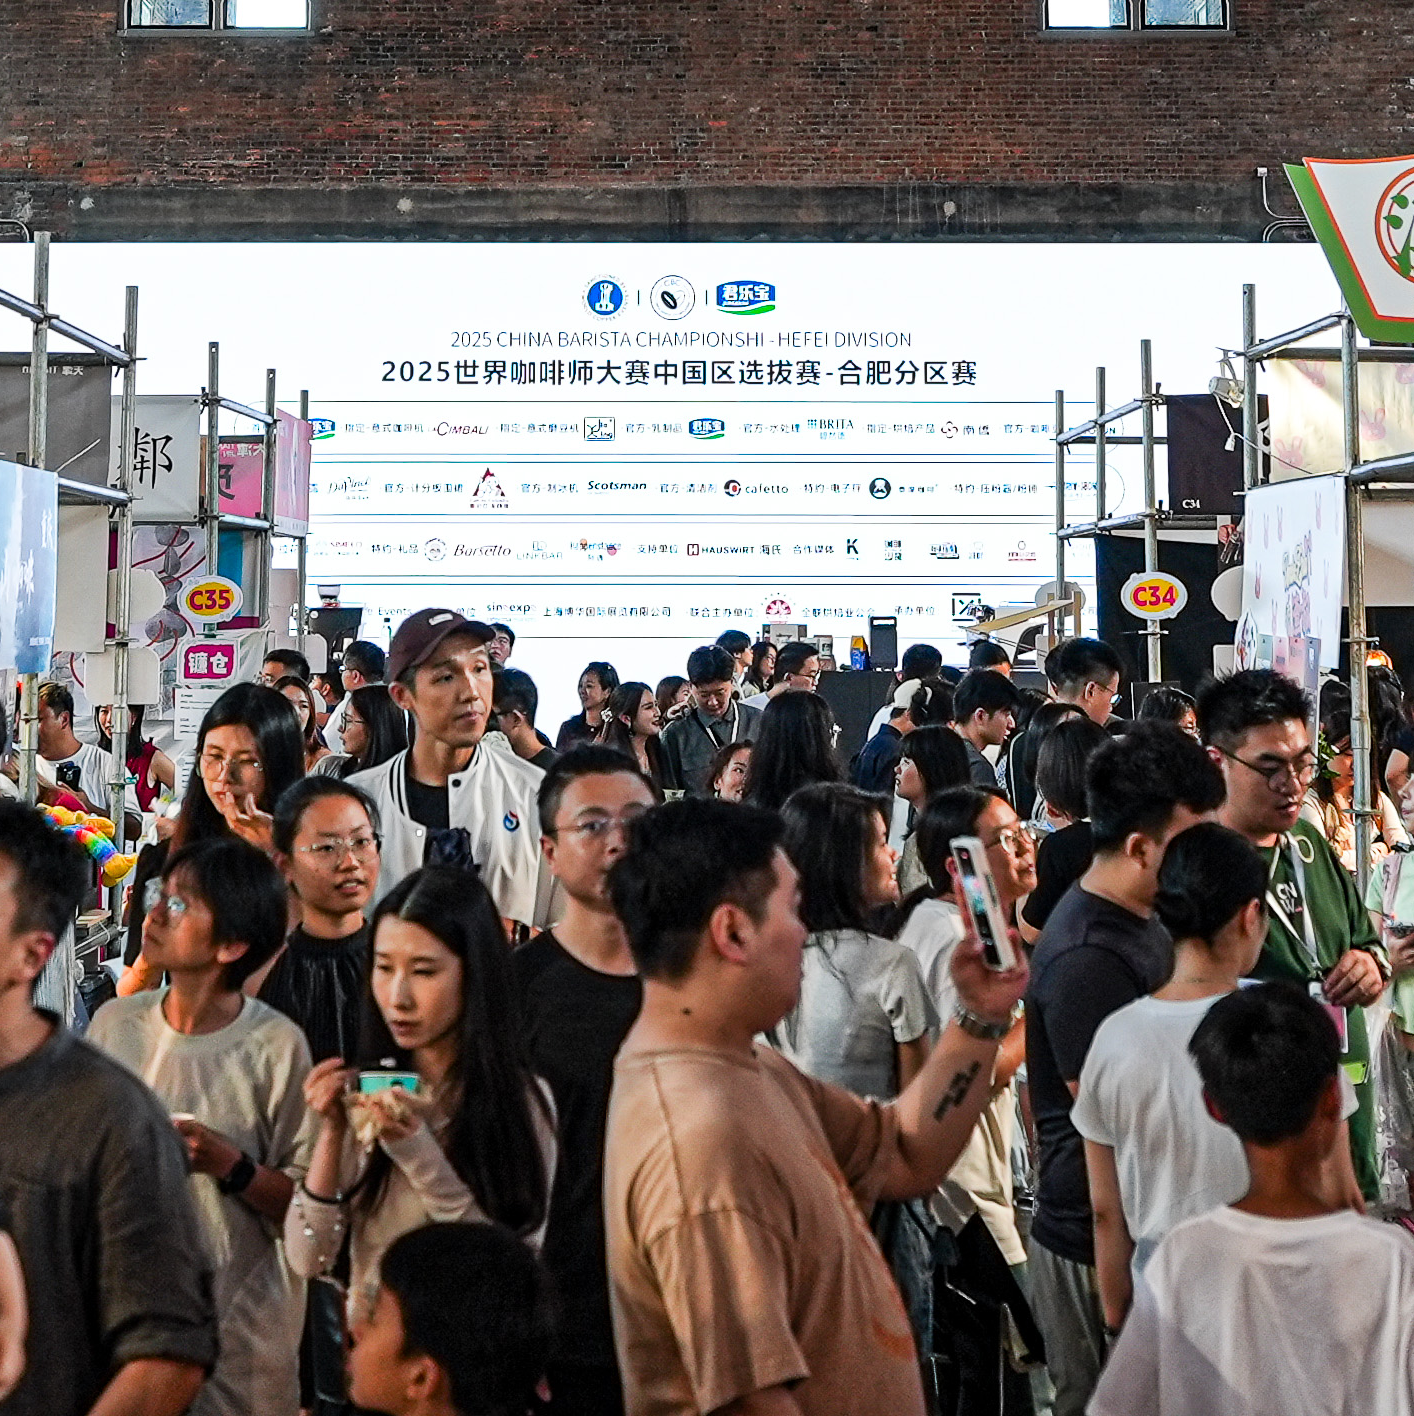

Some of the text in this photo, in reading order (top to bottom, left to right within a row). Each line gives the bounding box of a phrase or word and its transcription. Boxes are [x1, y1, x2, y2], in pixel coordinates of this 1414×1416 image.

[722, 284, 770, 301] 君乐宝
[451, 331, 492, 348] 2025
[496, 331, 553, 348] CHINA
[559, 331, 631, 348] BARISTA
[636, 331, 764, 348] CHAMPIONSHI
[778, 331, 828, 348] HEFEI
[834, 331, 912, 348] DIVISION
[381, 359, 977, 386] 2025世界咖啡师大赛中国区选拔赛-合肥分区赛
[819, 419, 854, 430] BRITA
[587, 481, 646, 491] Scotsman
[745, 483, 788, 494] cafetto
[453, 544, 512, 557] Barsetto
[702, 546, 755, 554] HAUSWIRT
[189, 589, 232, 611] C35
[1132, 584, 1177, 608] C34
